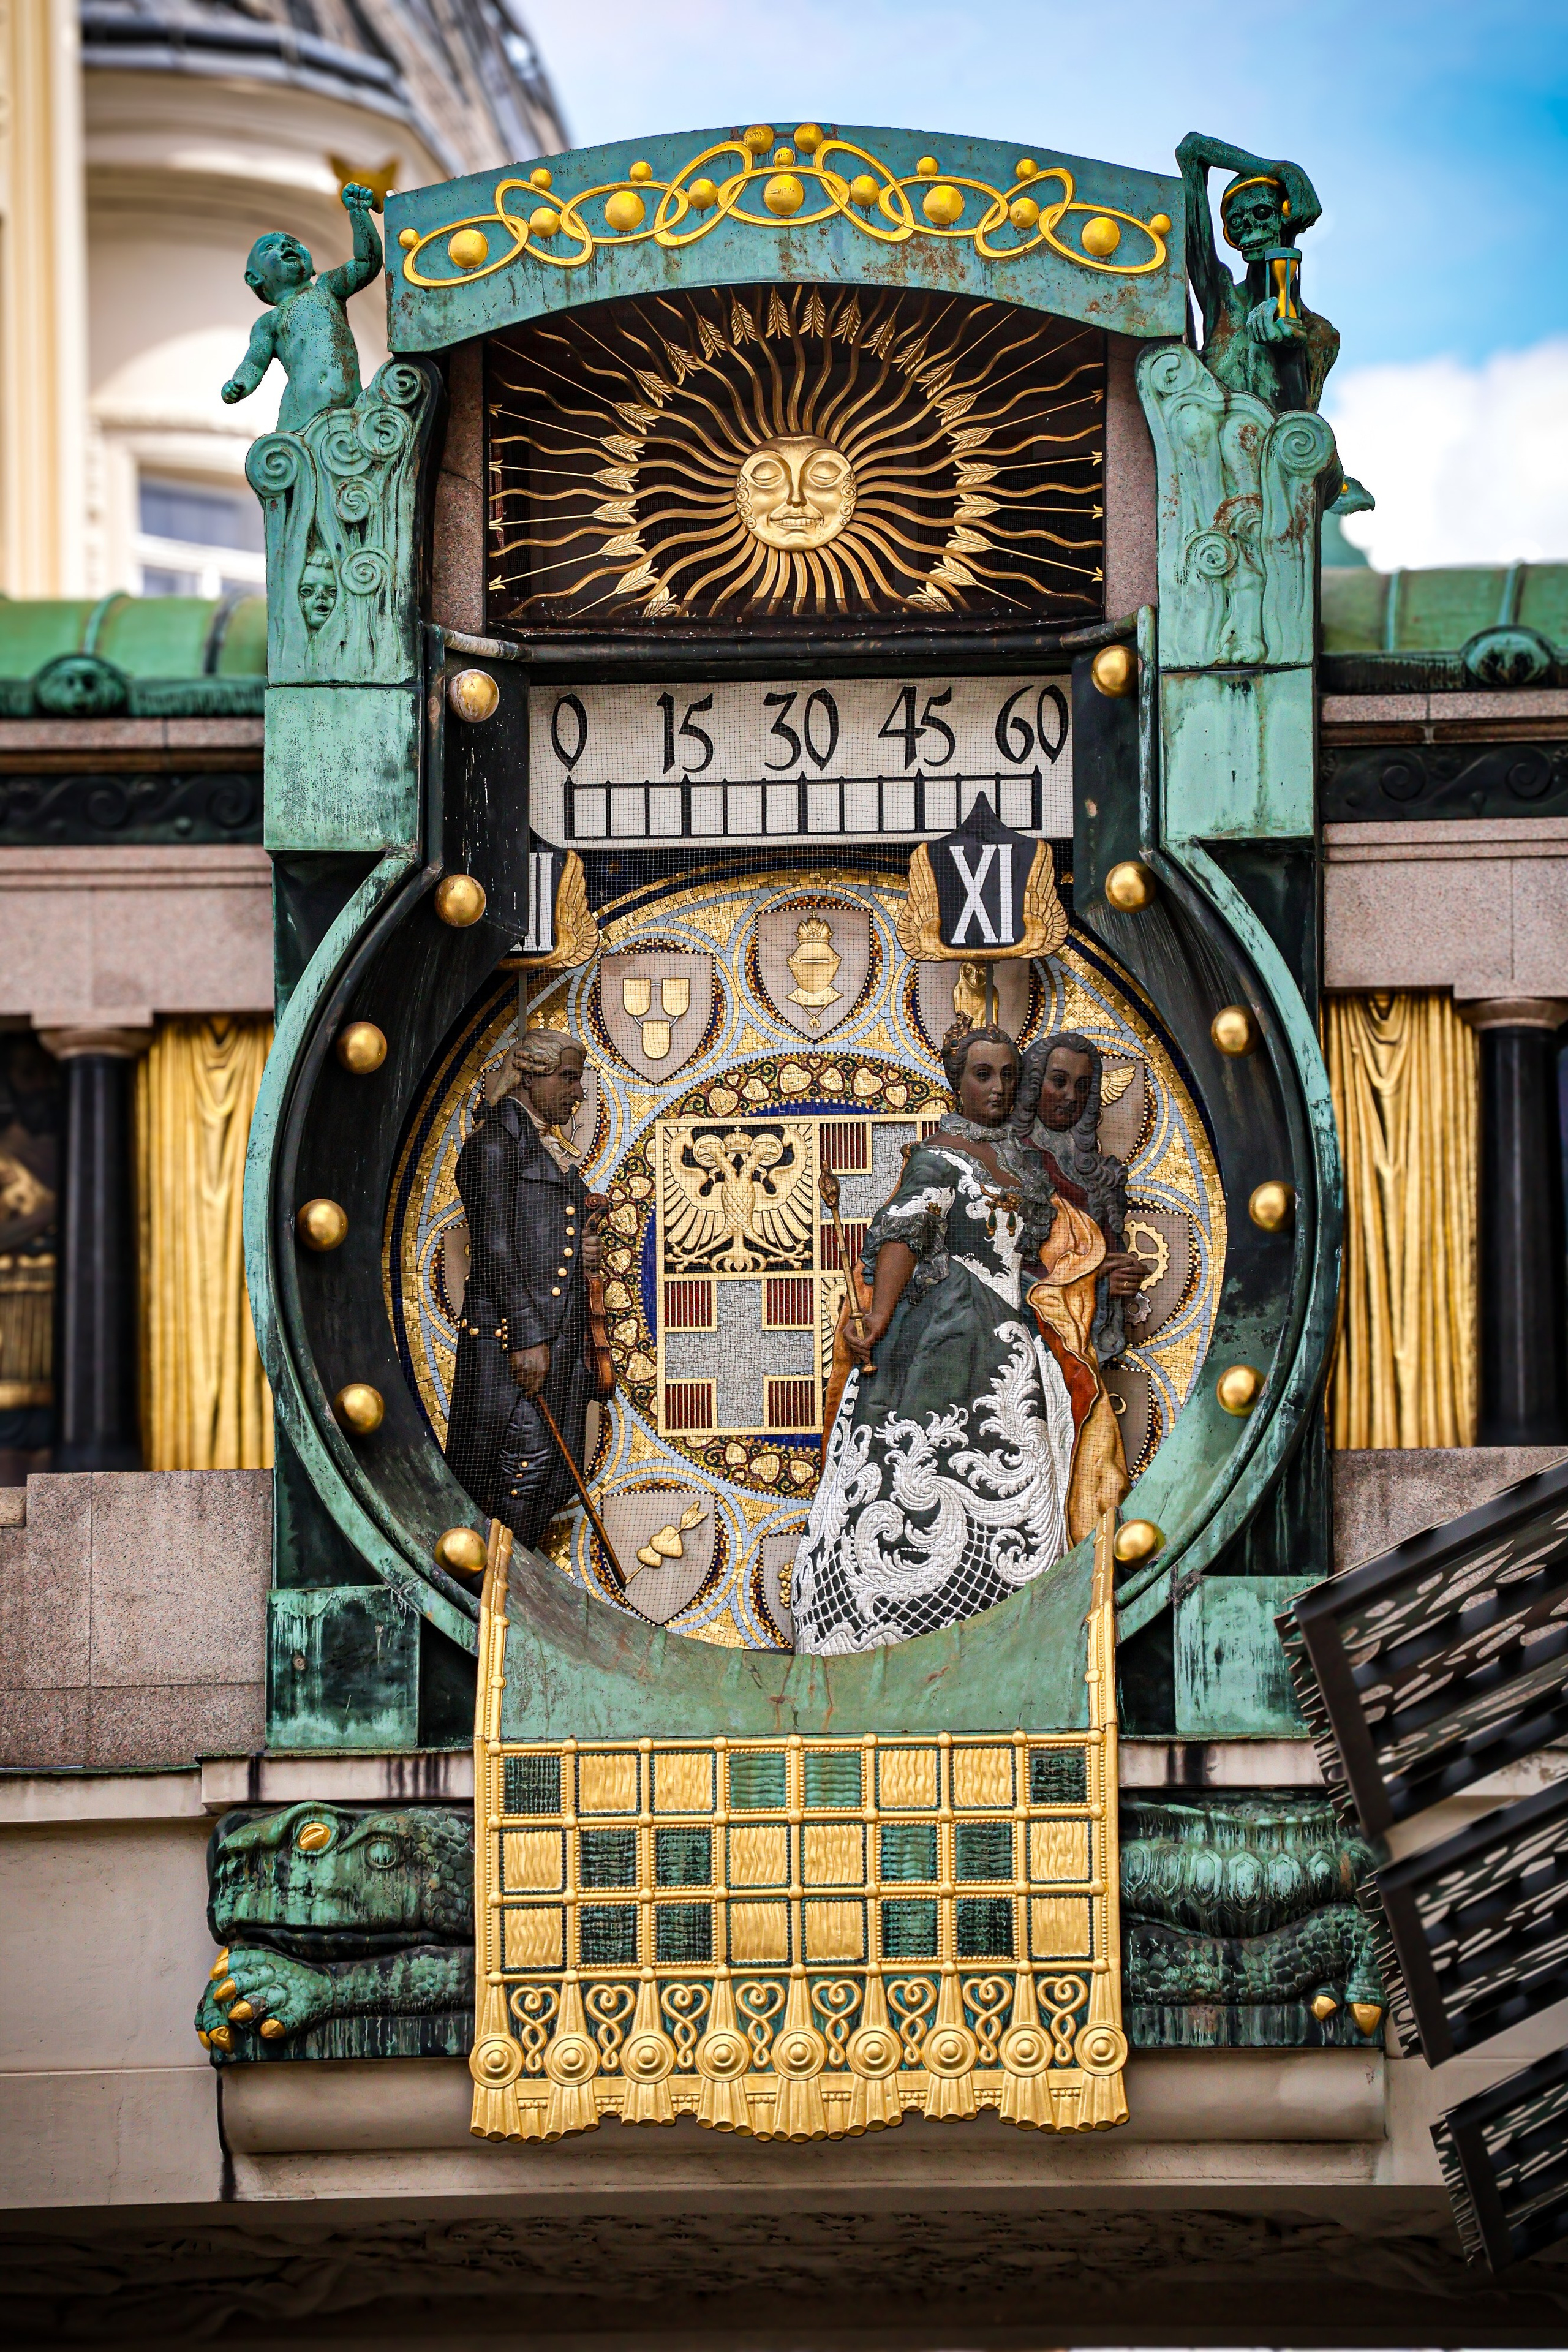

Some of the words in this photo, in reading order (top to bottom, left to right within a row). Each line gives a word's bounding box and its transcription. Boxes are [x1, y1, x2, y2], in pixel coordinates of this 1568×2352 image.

[551, 693, 588, 771] 0
[657, 692, 714, 774] 15
[763, 688, 839, 771] 30
[878, 685, 957, 770] 45
[995, 684, 1069, 764] 60
[949, 843, 1014, 944] XI
